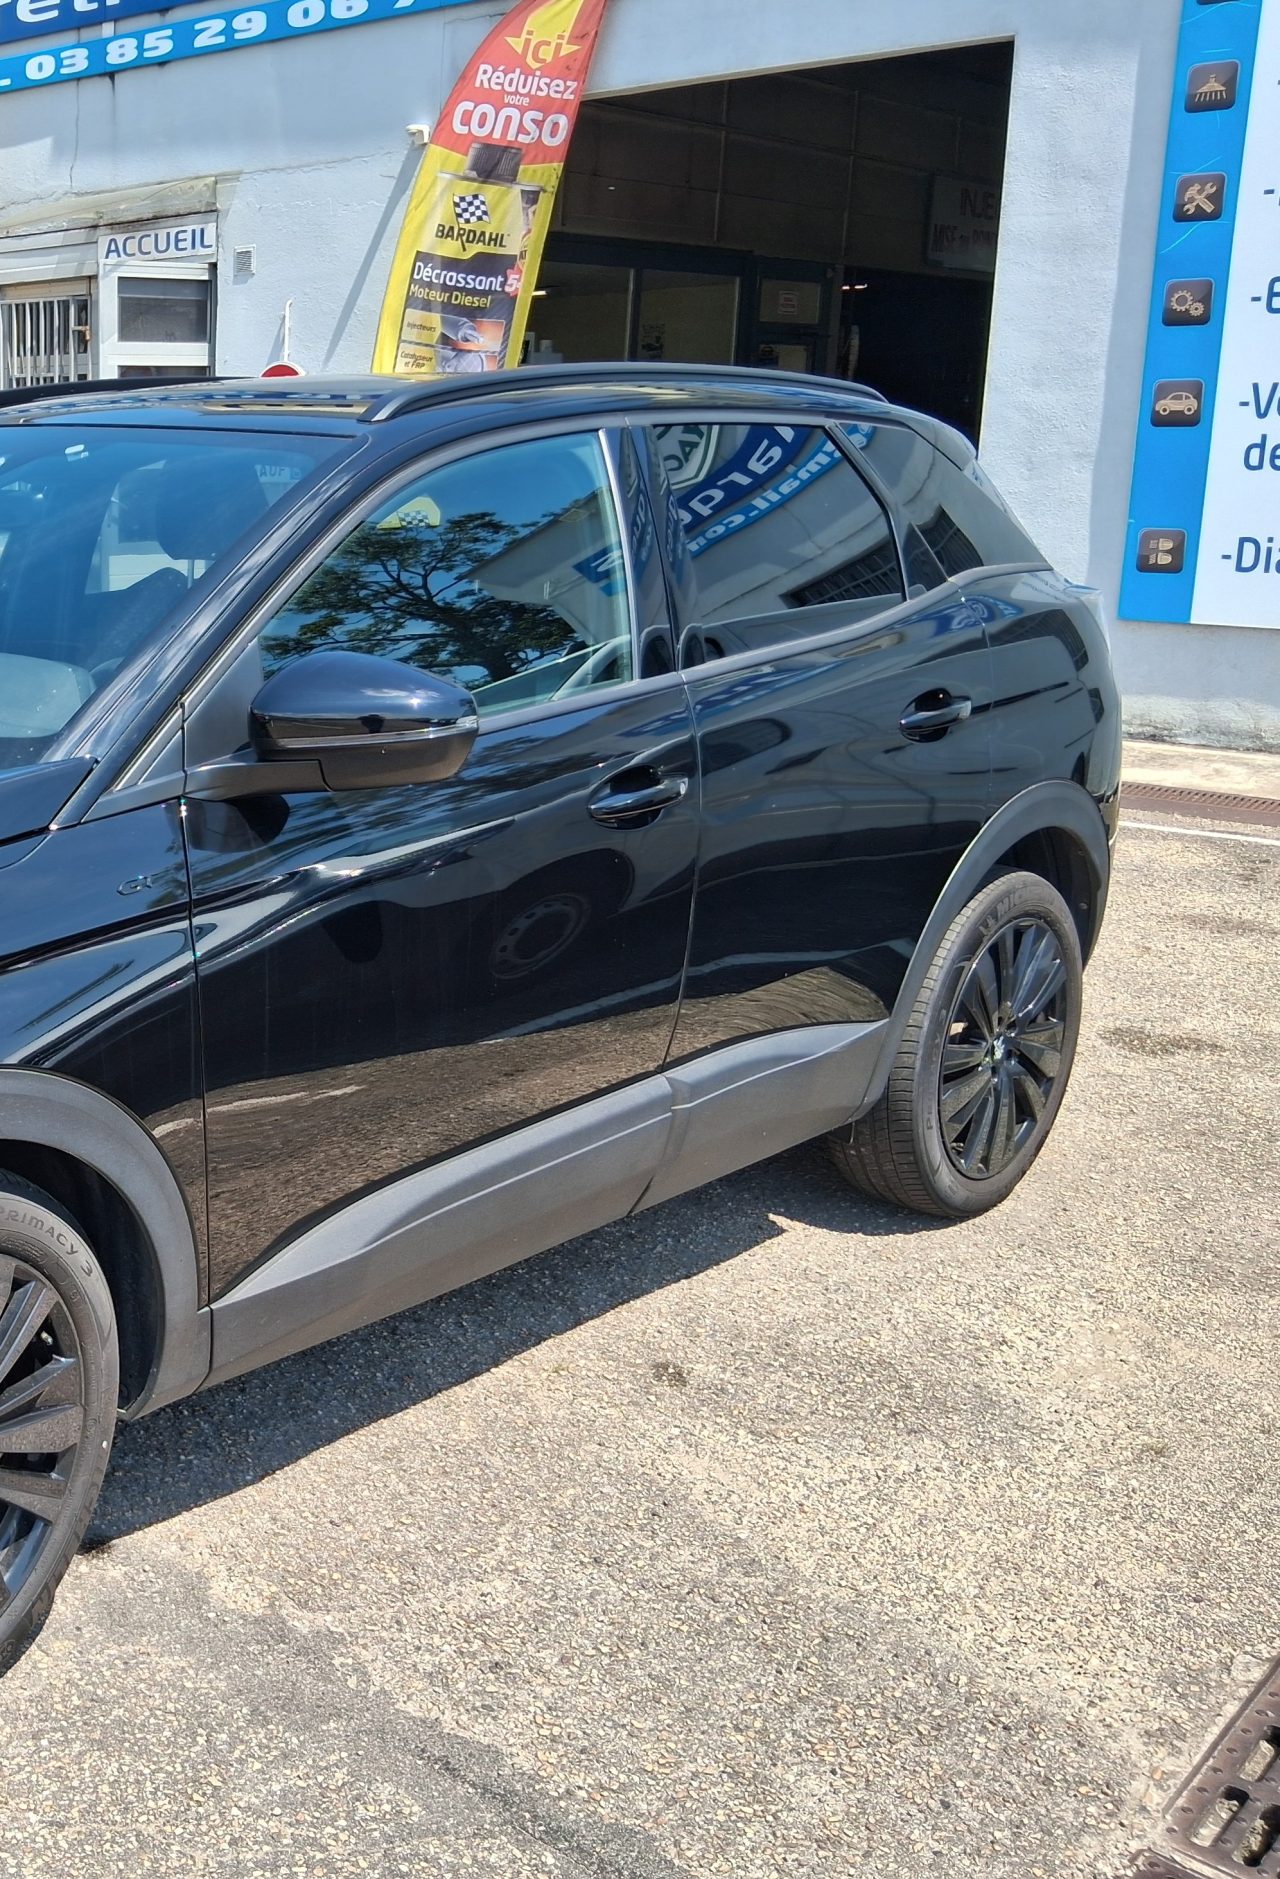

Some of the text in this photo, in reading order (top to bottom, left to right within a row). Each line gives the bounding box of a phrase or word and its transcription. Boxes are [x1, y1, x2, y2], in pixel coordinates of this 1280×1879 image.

[25, 48, 89, 80] 03
[105, 29, 173, 64] 85
[193, 11, 267, 48] 29
[521, 30, 566, 64] ici
[474, 63, 577, 100] Réduisez
[504, 94, 530, 106] votre
[105, 228, 213, 262] ACCUEIL
[435, 223, 508, 252] BARDAHL
[413, 261, 505, 292] Décrassant
[409, 283, 492, 309] Moteur Diesel
[1239, 382, 1280, 420] -V
[1221, 536, 1280, 574] -Di
[81, 1259, 94, 1278] 3
